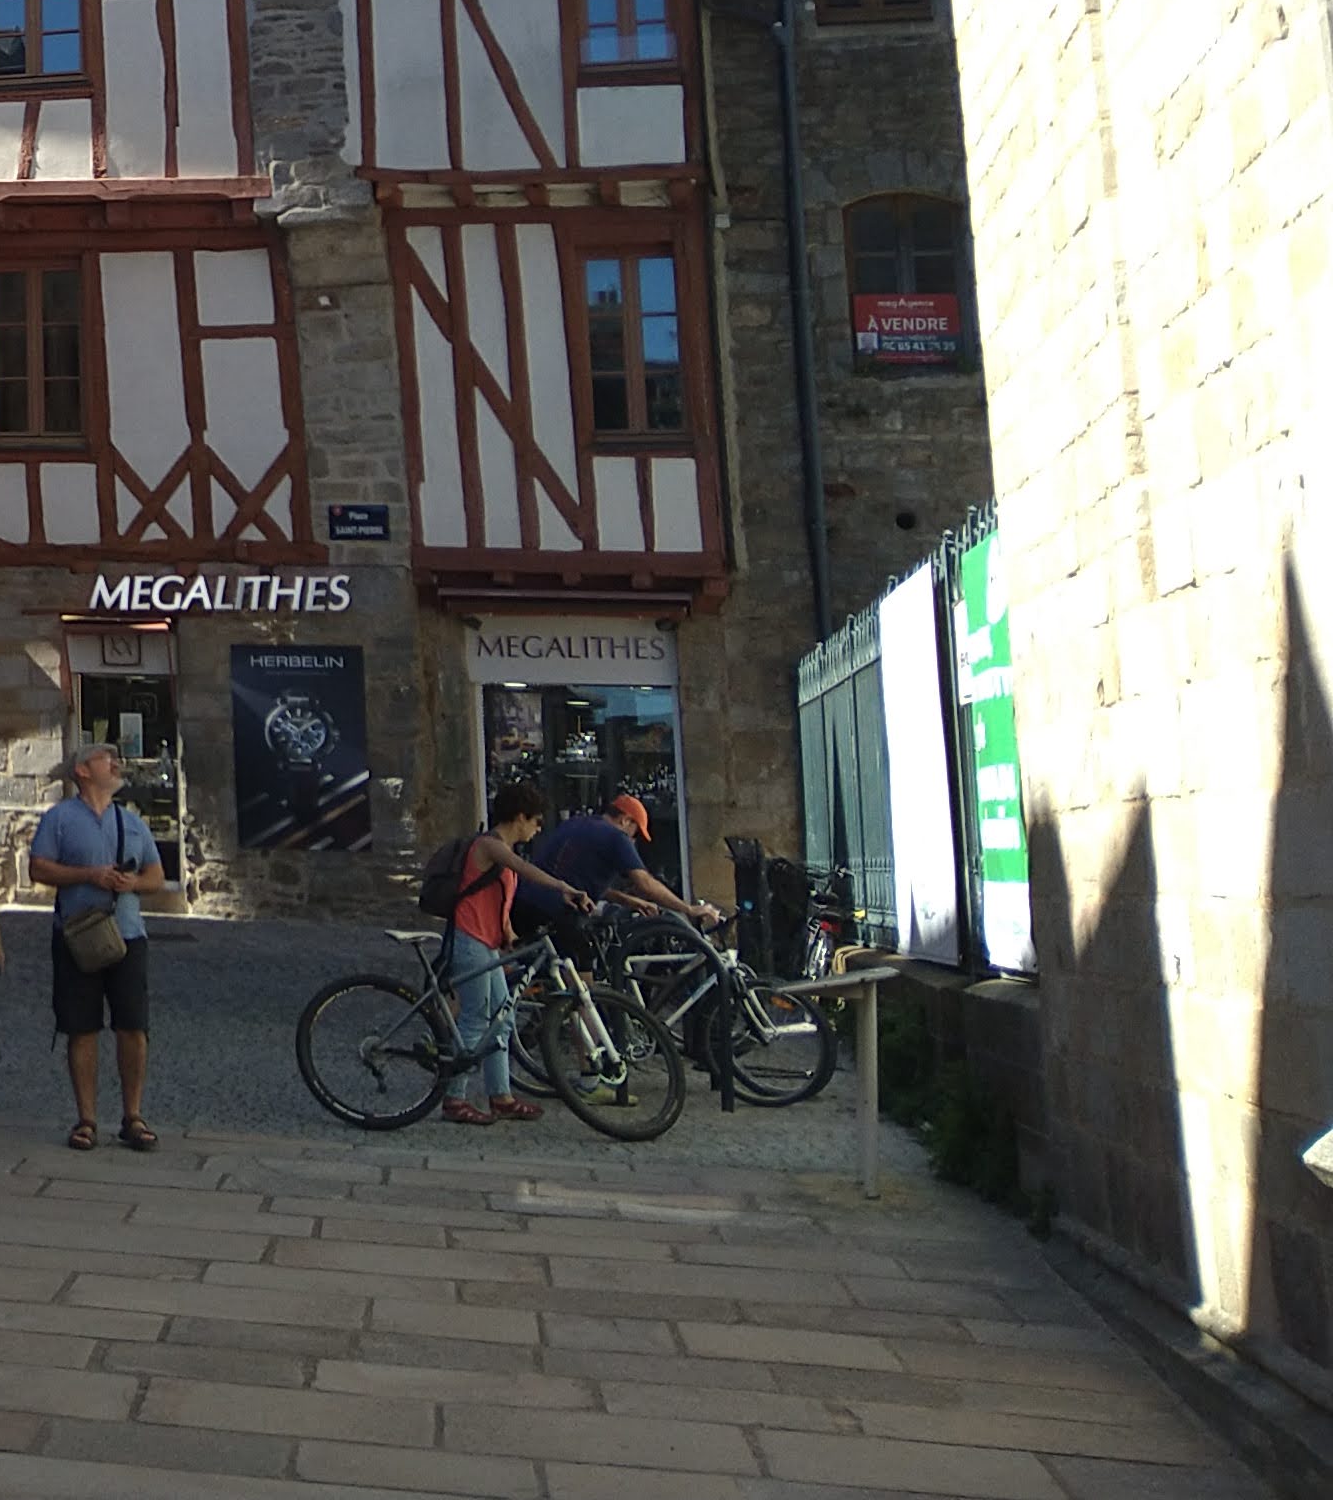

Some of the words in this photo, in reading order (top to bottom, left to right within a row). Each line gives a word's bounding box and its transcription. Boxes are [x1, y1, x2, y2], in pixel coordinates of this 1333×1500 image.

[868, 315, 879, 331] À
[881, 317, 948, 331] VENDRE
[89, 574, 351, 612] MEGALITHES
[477, 635, 665, 660] MEGALITHES
[250, 655, 345, 668] HERBELIN
